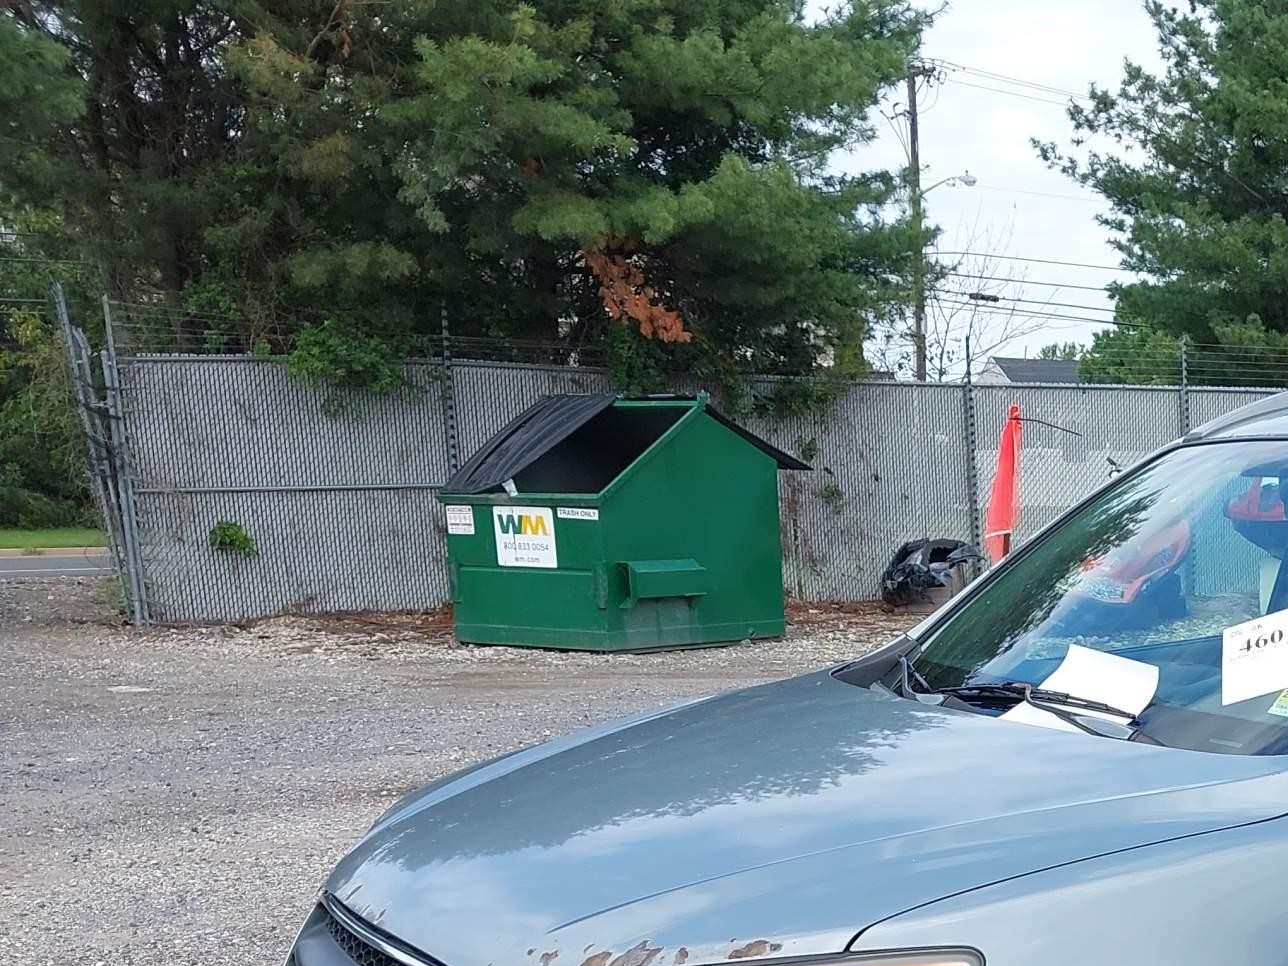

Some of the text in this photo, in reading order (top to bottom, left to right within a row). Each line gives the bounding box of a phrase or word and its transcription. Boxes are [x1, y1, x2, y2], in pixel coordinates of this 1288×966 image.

[559, 508, 596, 518] TRASH ONLY
[497, 514, 549, 536] WM
[518, 542, 531, 551] 833
[532, 542, 549, 551] 0054
